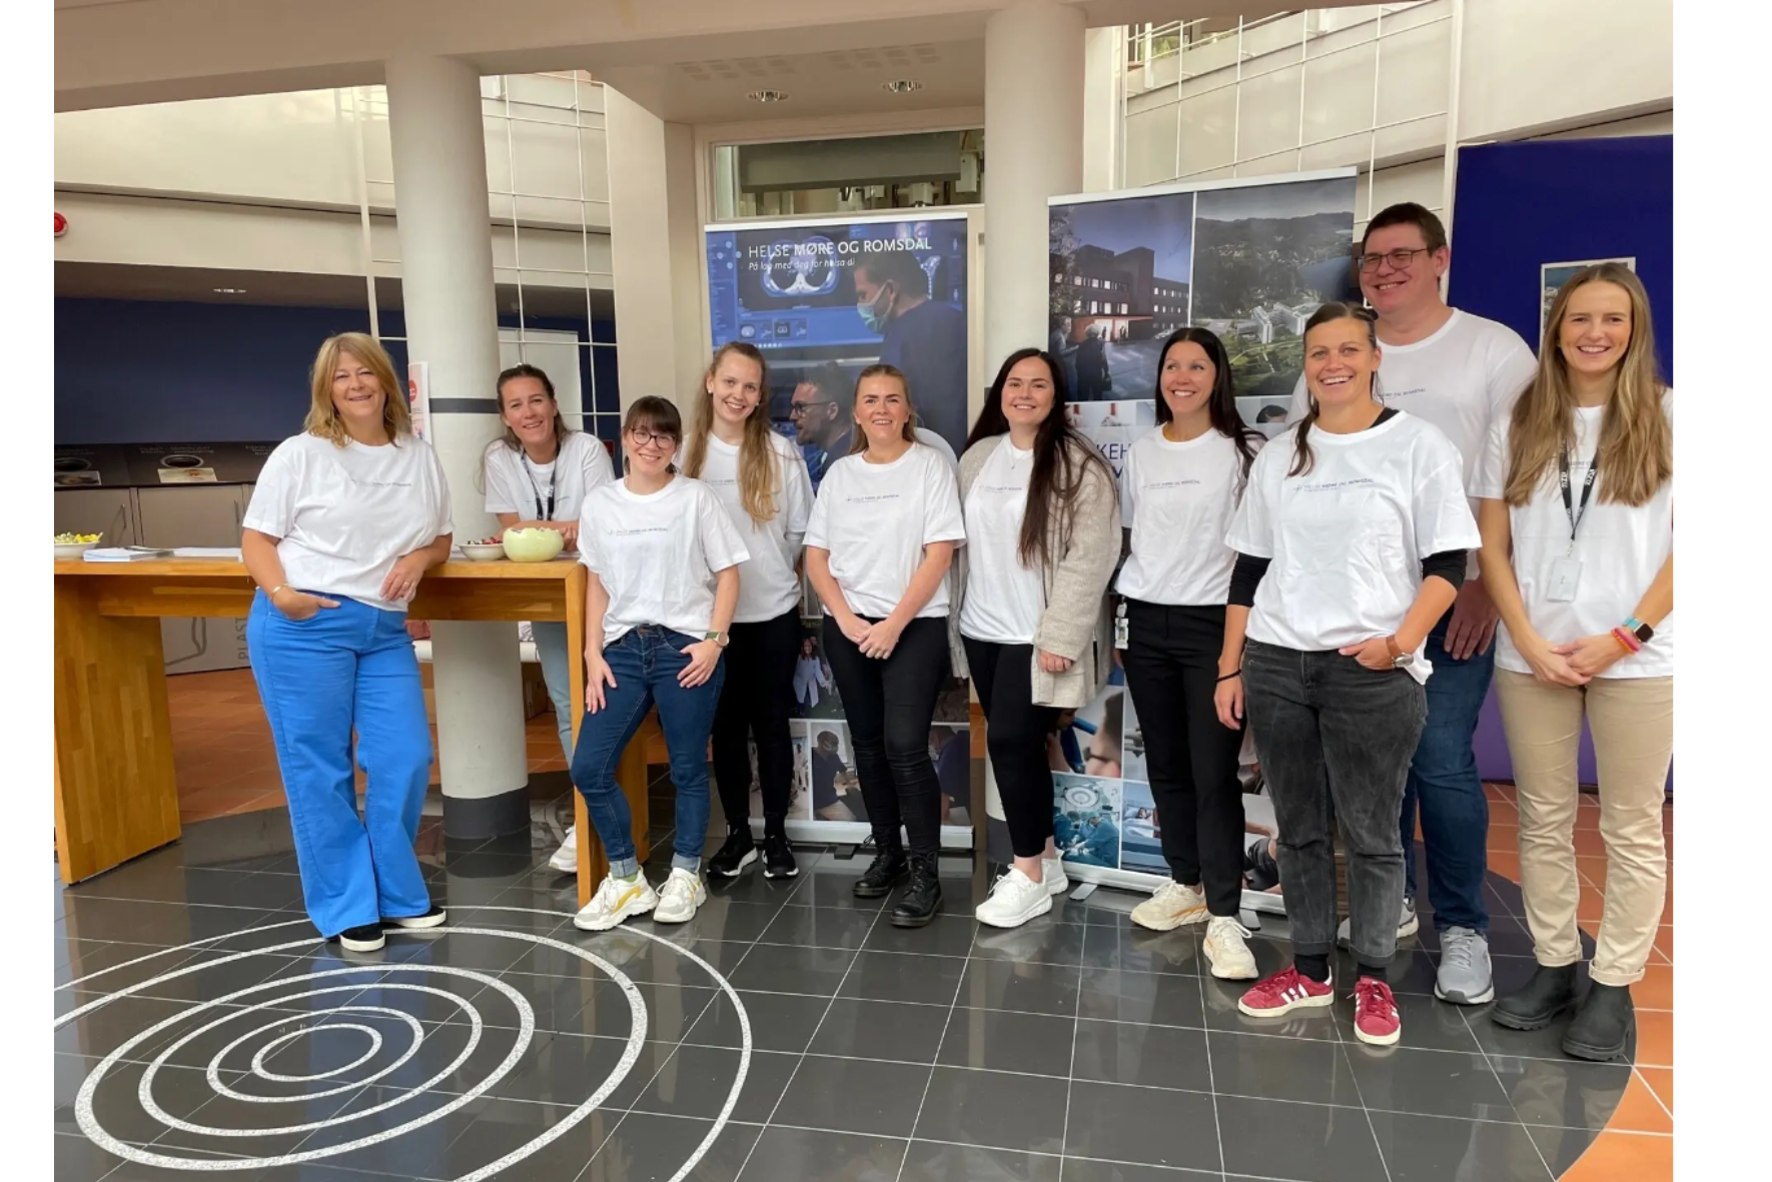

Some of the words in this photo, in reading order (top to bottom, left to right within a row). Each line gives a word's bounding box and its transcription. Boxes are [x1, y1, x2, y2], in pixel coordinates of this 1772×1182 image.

[748, 244, 790, 258] HELSE
[794, 241, 834, 256] MØRE
[837, 240, 859, 254] OG
[863, 237, 932, 253] ROMSDAL
[748, 262, 759, 271] På
[775, 260, 792, 269] med
[810, 260, 823, 271] for
[847, 257, 855, 267] di
